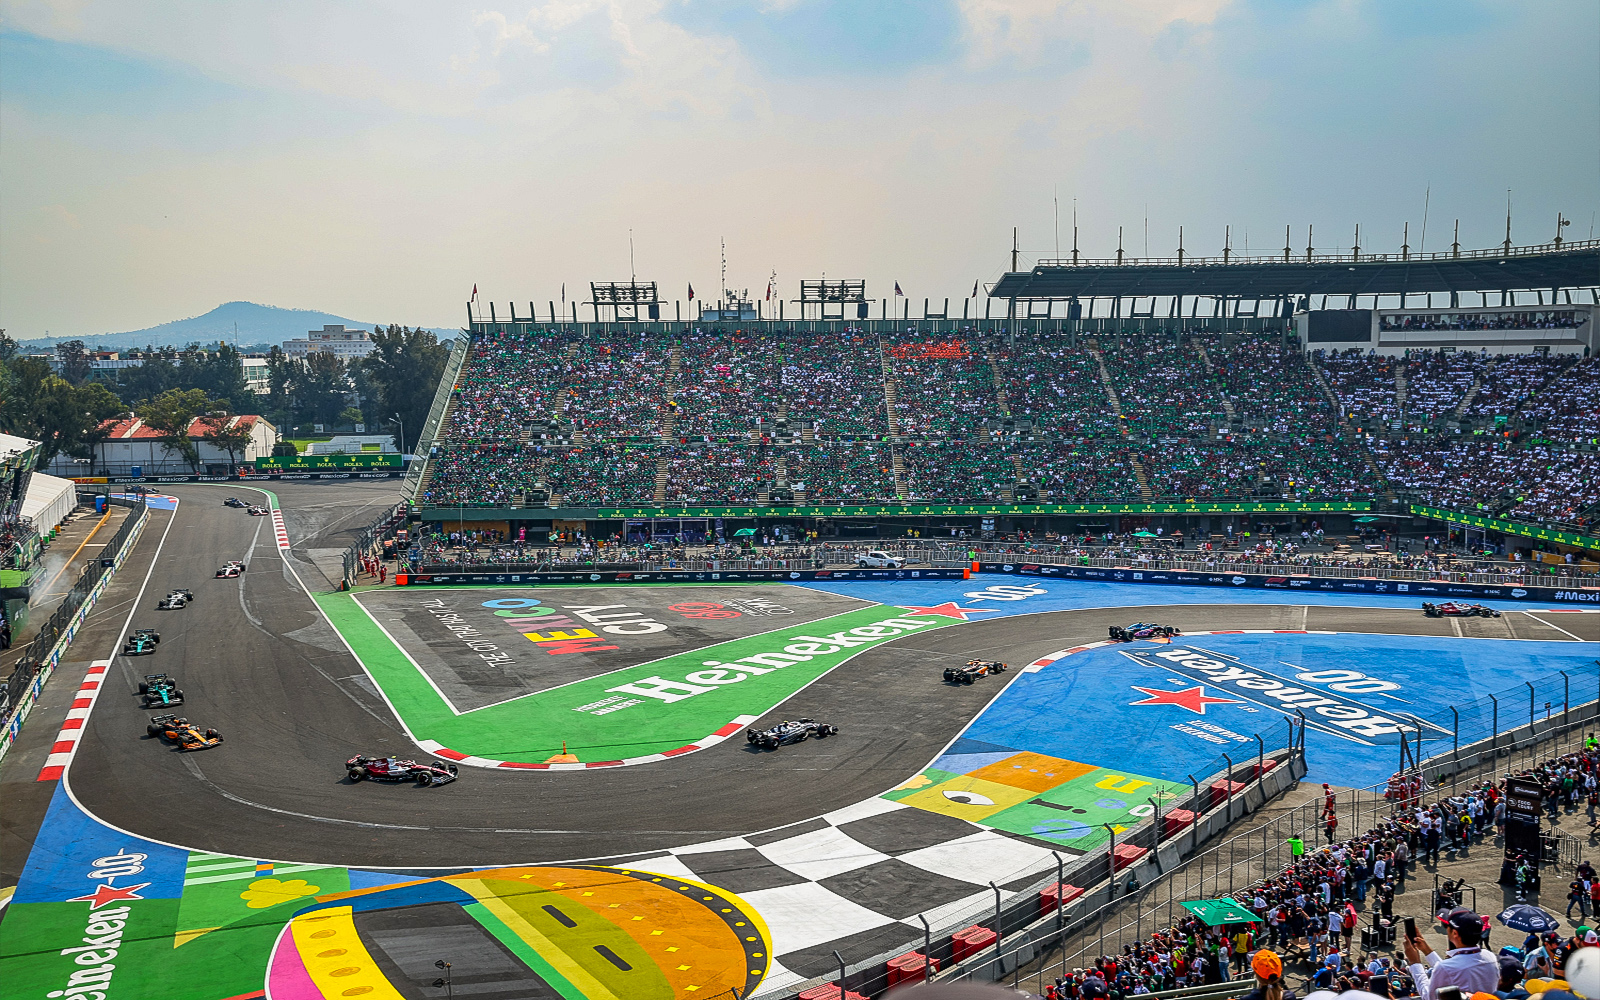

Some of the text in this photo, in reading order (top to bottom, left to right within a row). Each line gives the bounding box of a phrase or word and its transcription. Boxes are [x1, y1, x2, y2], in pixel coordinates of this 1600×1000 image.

[481, 598, 620, 655] MEXICO
[562, 604, 668, 635] CITY
[604, 617, 938, 704] Heineken
[1154, 649, 1416, 737] Heineken
